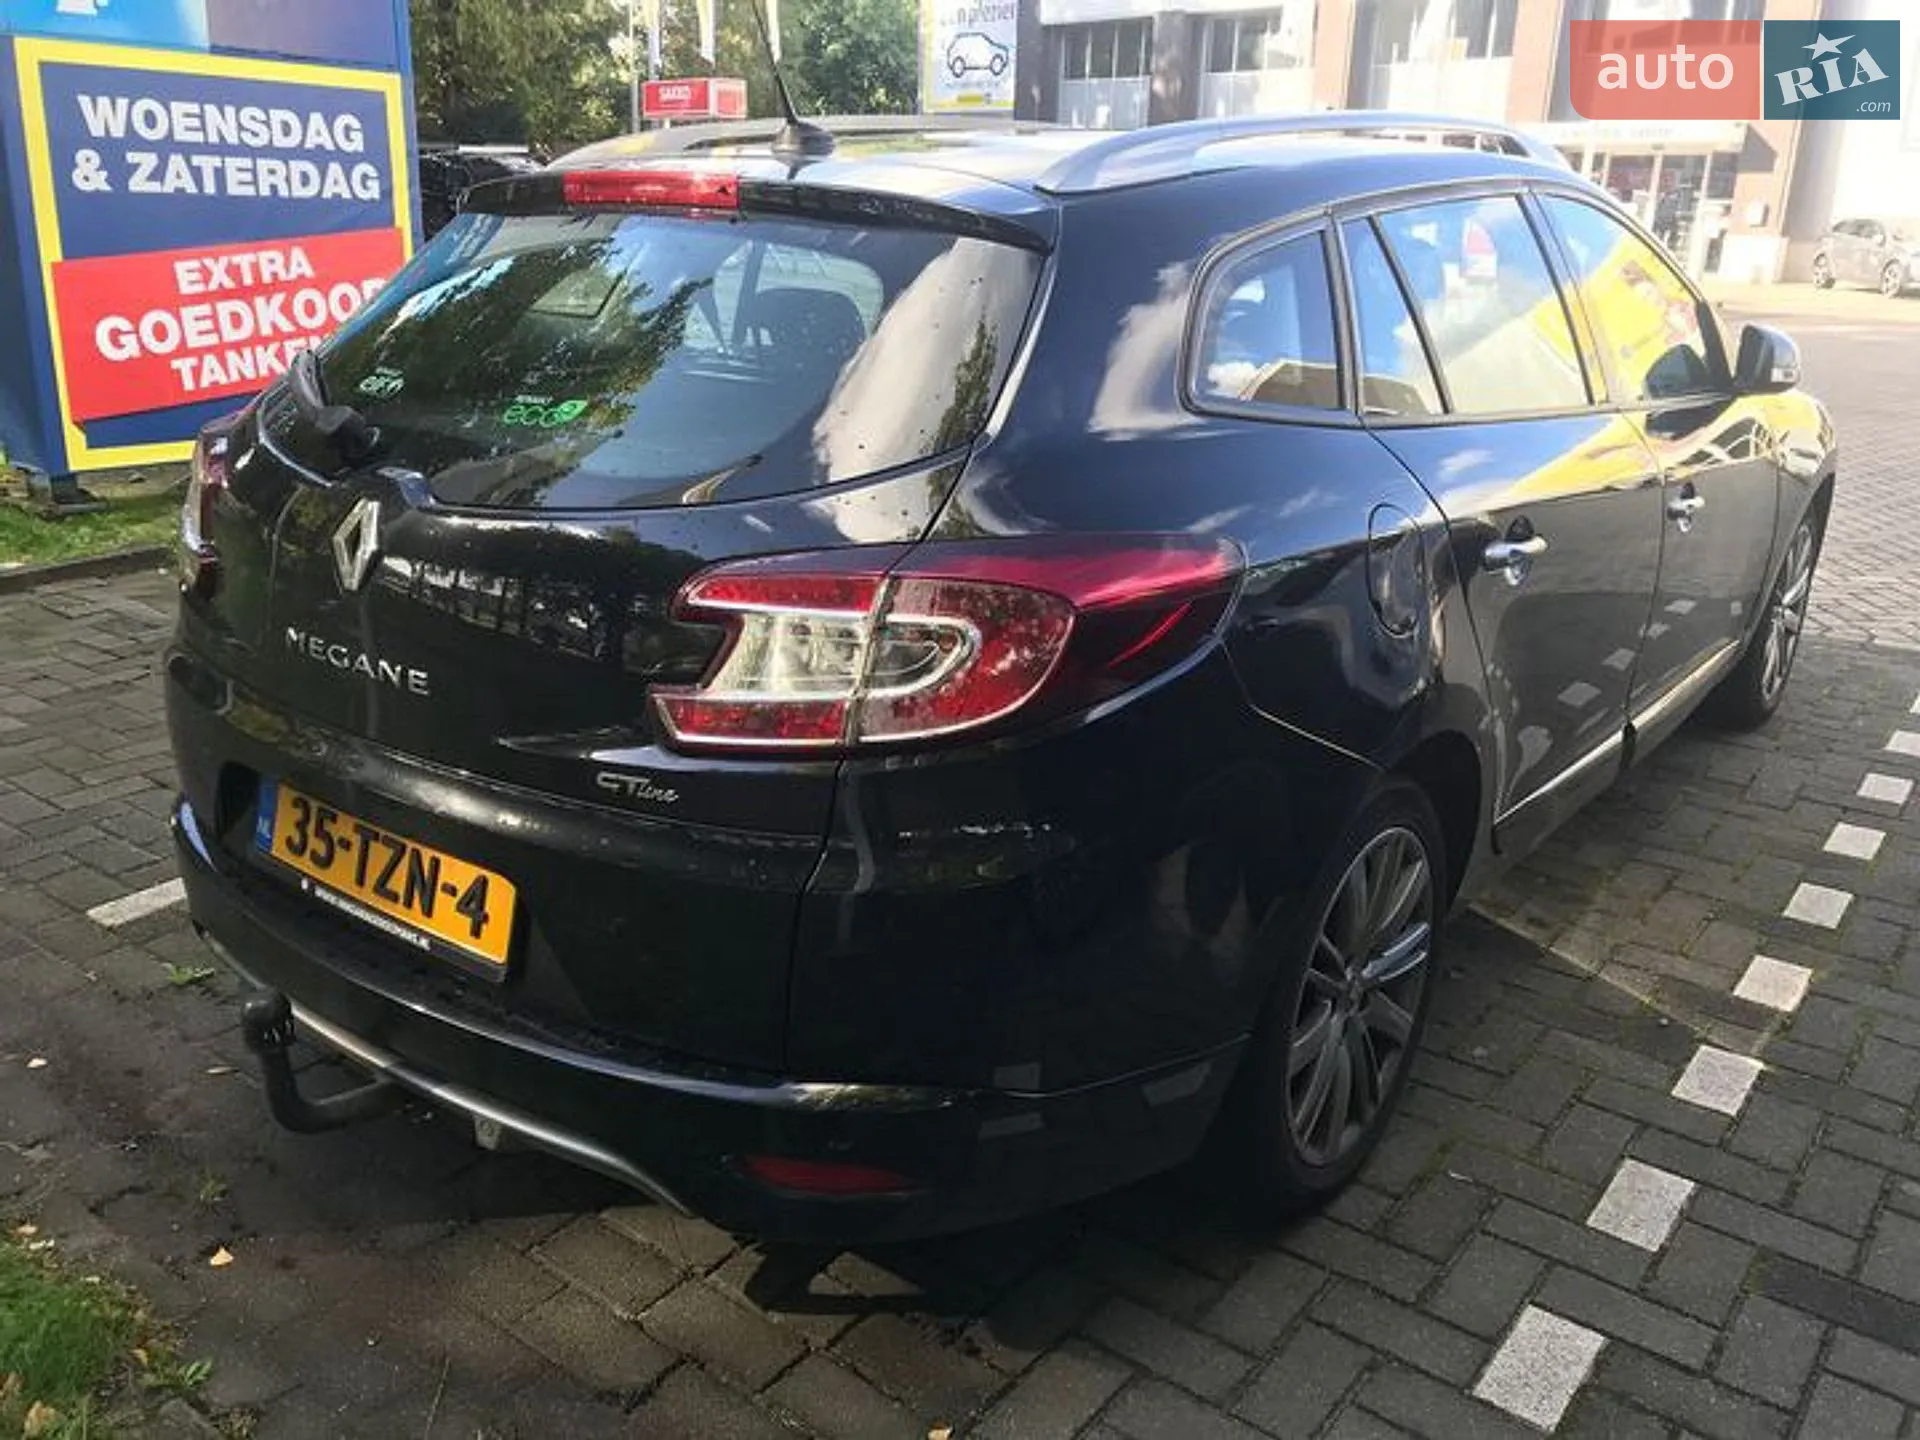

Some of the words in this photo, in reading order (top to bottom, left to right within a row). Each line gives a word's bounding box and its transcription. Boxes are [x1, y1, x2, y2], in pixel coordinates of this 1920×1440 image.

[77, 94, 364, 153] WOENSDAG
[71, 149, 111, 194] &
[126, 152, 381, 200] ZATERDAG
[174, 247, 314, 296] EXTRA
[171, 335, 322, 391] TANK
[286, 627, 431, 696] MEGANE
[285, 797, 489, 940] 35-TZN-4
